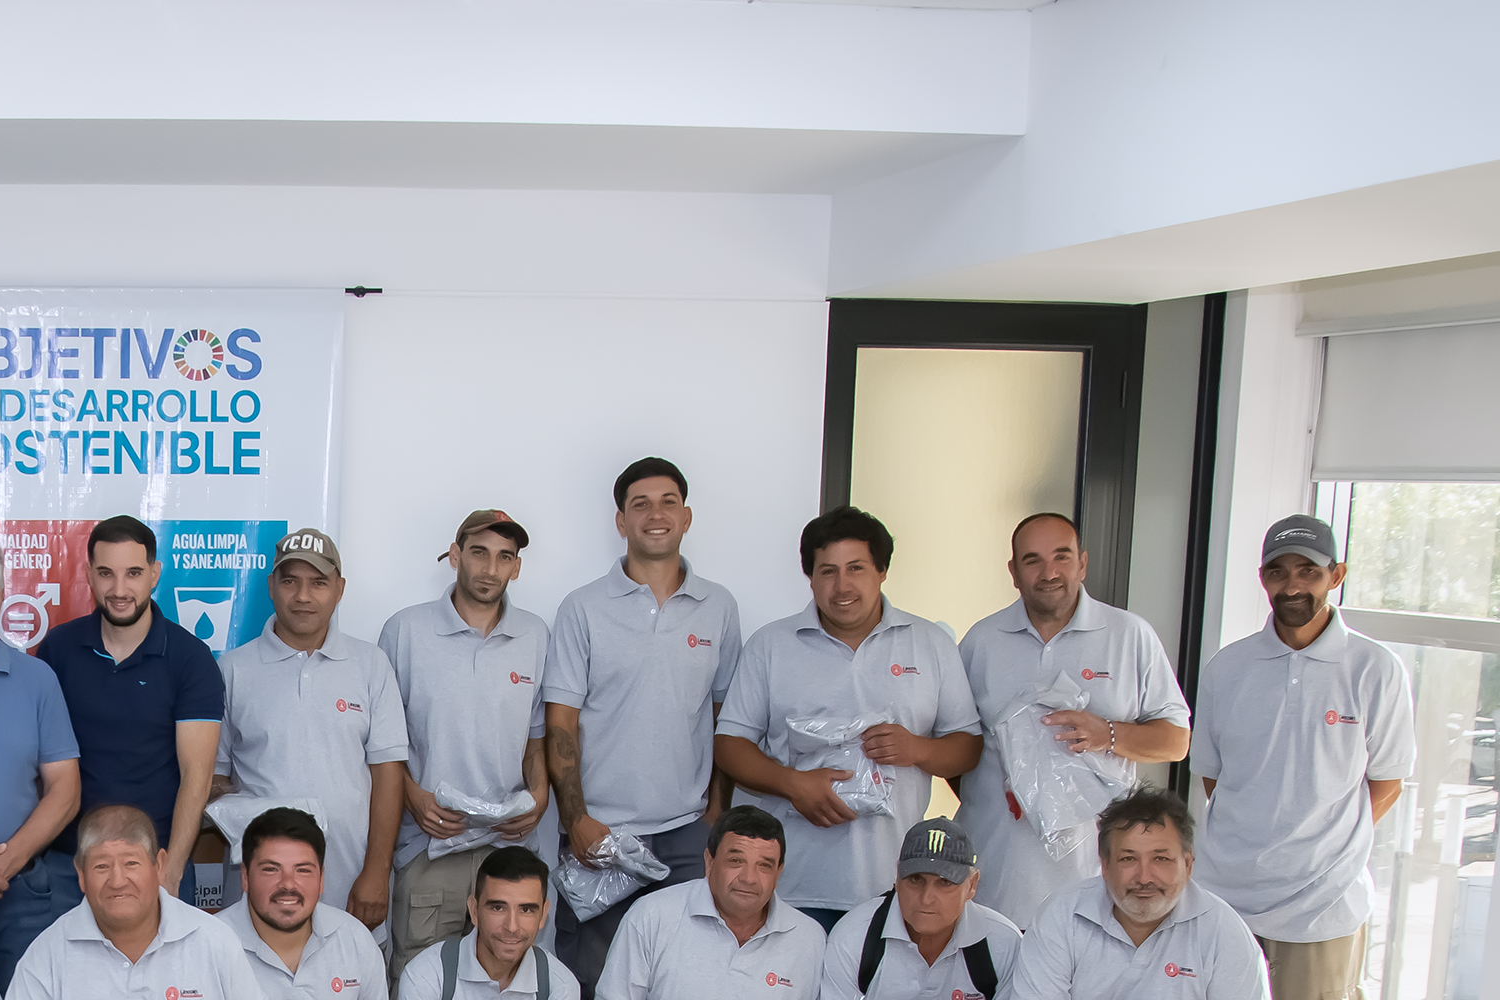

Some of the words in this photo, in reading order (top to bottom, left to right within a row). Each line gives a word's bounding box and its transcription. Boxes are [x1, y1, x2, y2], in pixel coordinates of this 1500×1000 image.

[0, 388, 261, 423] DESARROLLO
[172, 533, 206, 549] AGUA
[207, 533, 248, 549] LIMPIA
[282, 534, 324, 554] ICON
[4, 551, 52, 569] GÉNERO
[172, 554, 181, 569] Y
[182, 554, 267, 570] SANEAMIENTO
